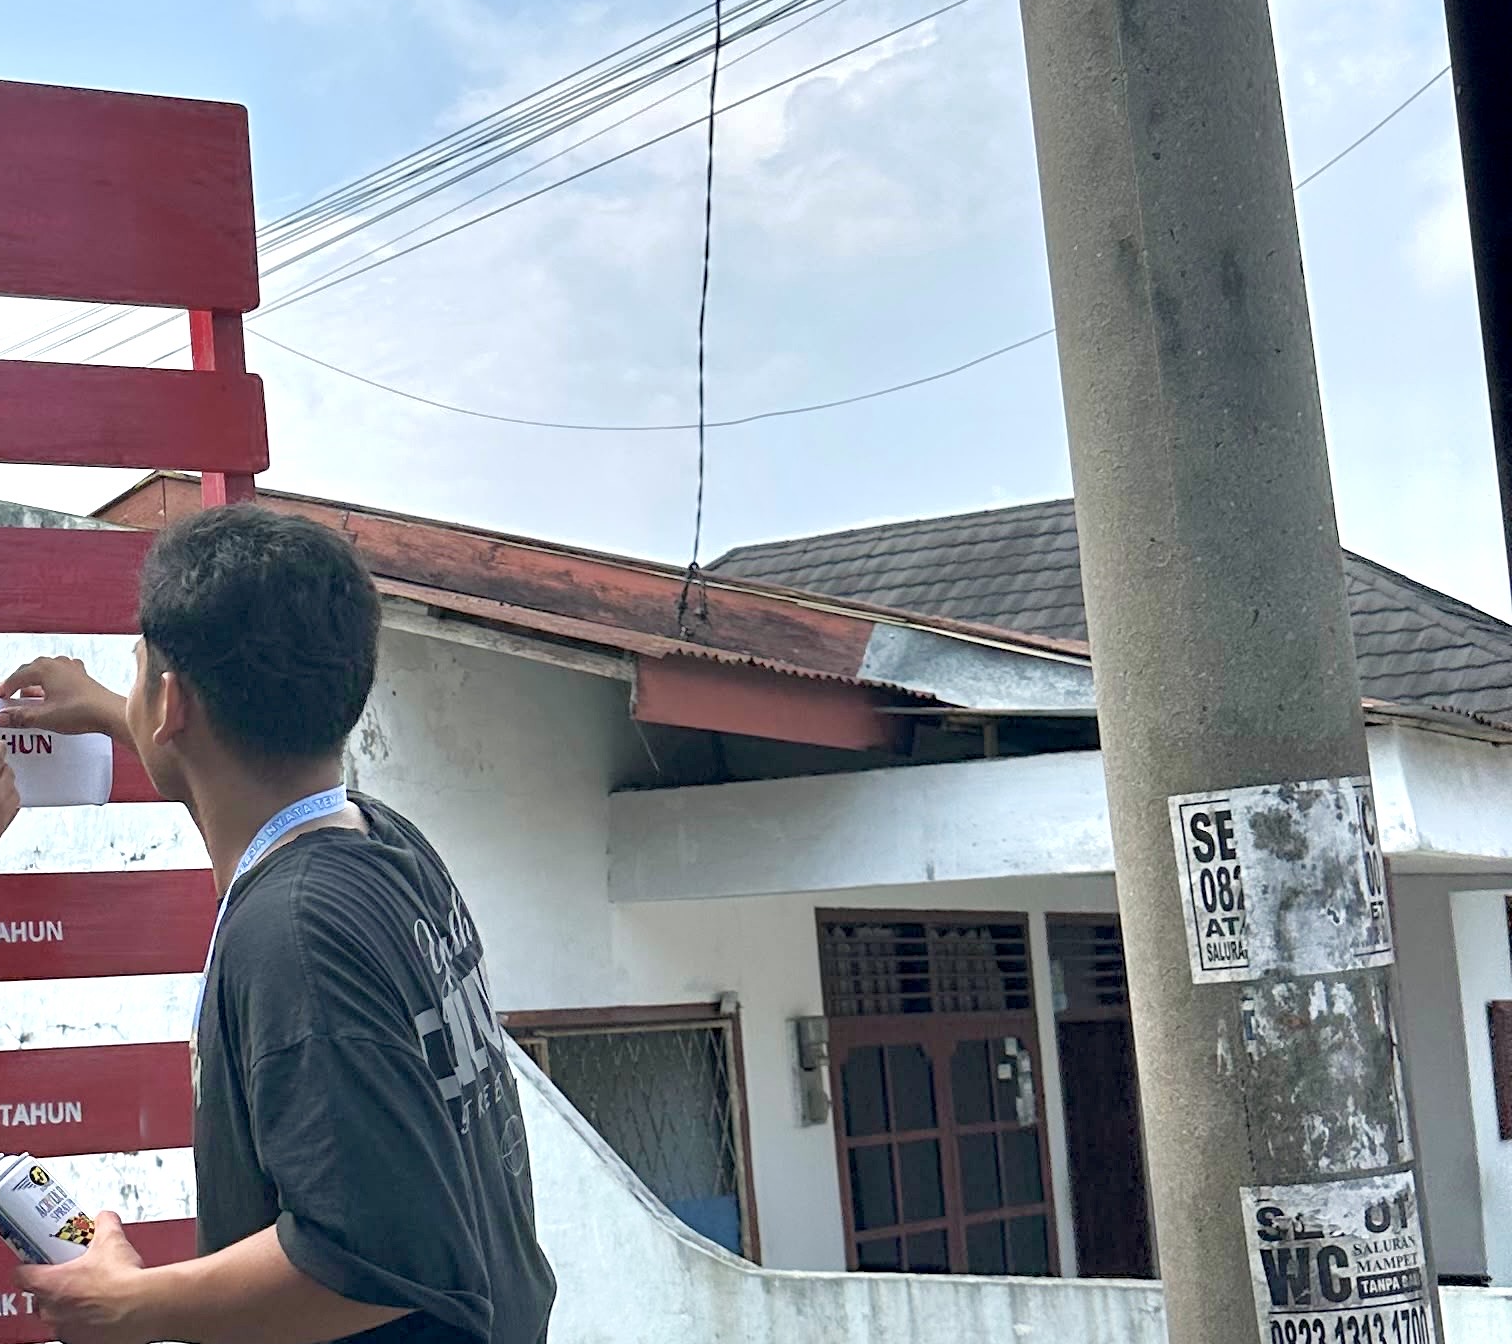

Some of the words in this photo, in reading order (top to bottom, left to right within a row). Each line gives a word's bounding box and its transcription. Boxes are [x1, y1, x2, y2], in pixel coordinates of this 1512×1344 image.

[264, 803, 313, 837] NYATA
[1206, 940, 1249, 963] SALURA
[1256, 1191, 1410, 1242] SOT
[1352, 1234, 1417, 1256] SALURAN
[1355, 1252, 1419, 1274] MAMPET
[1260, 1244, 1352, 1306] WC
[1361, 1275, 1400, 1294] TANPA
